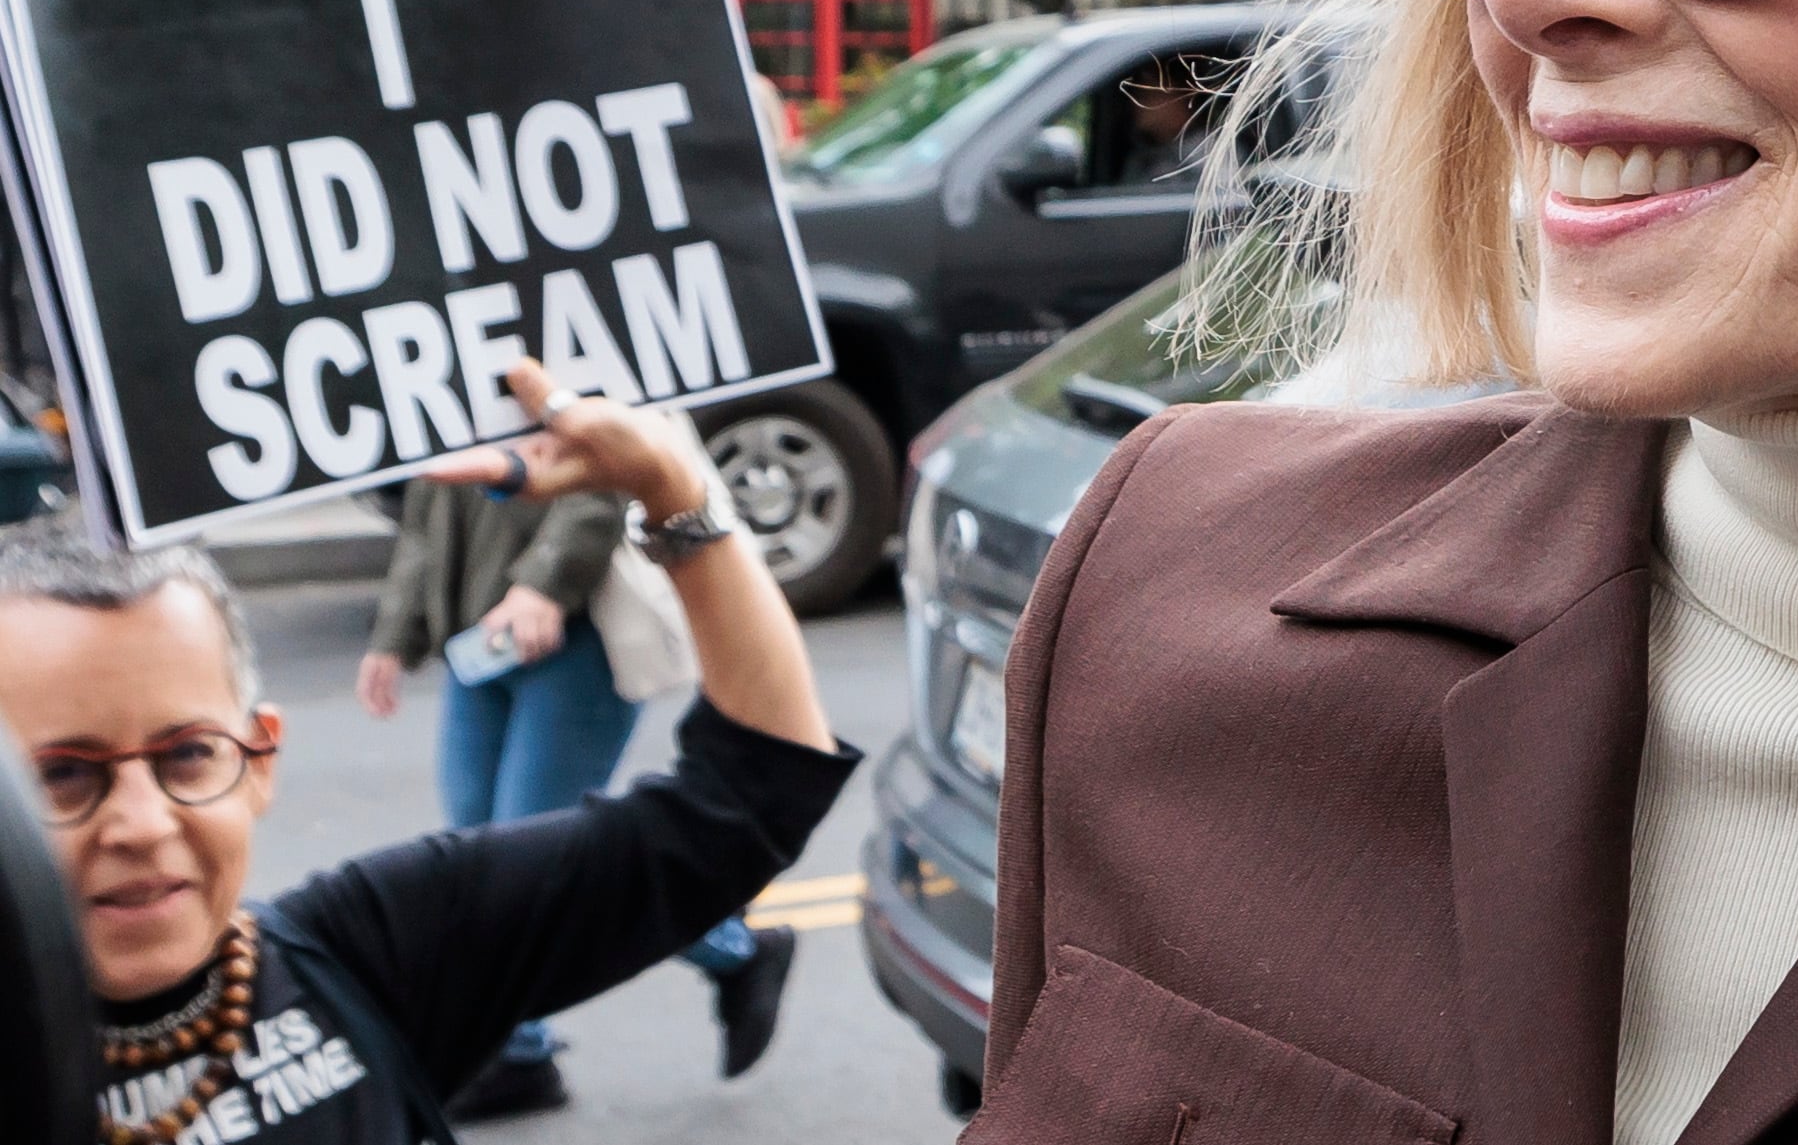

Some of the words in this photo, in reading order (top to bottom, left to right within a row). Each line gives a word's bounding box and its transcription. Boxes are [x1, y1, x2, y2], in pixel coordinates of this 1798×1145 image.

[147, 135, 396, 324] DID
[413, 82, 693, 273] NOT
[194, 240, 751, 502] SCREAM
